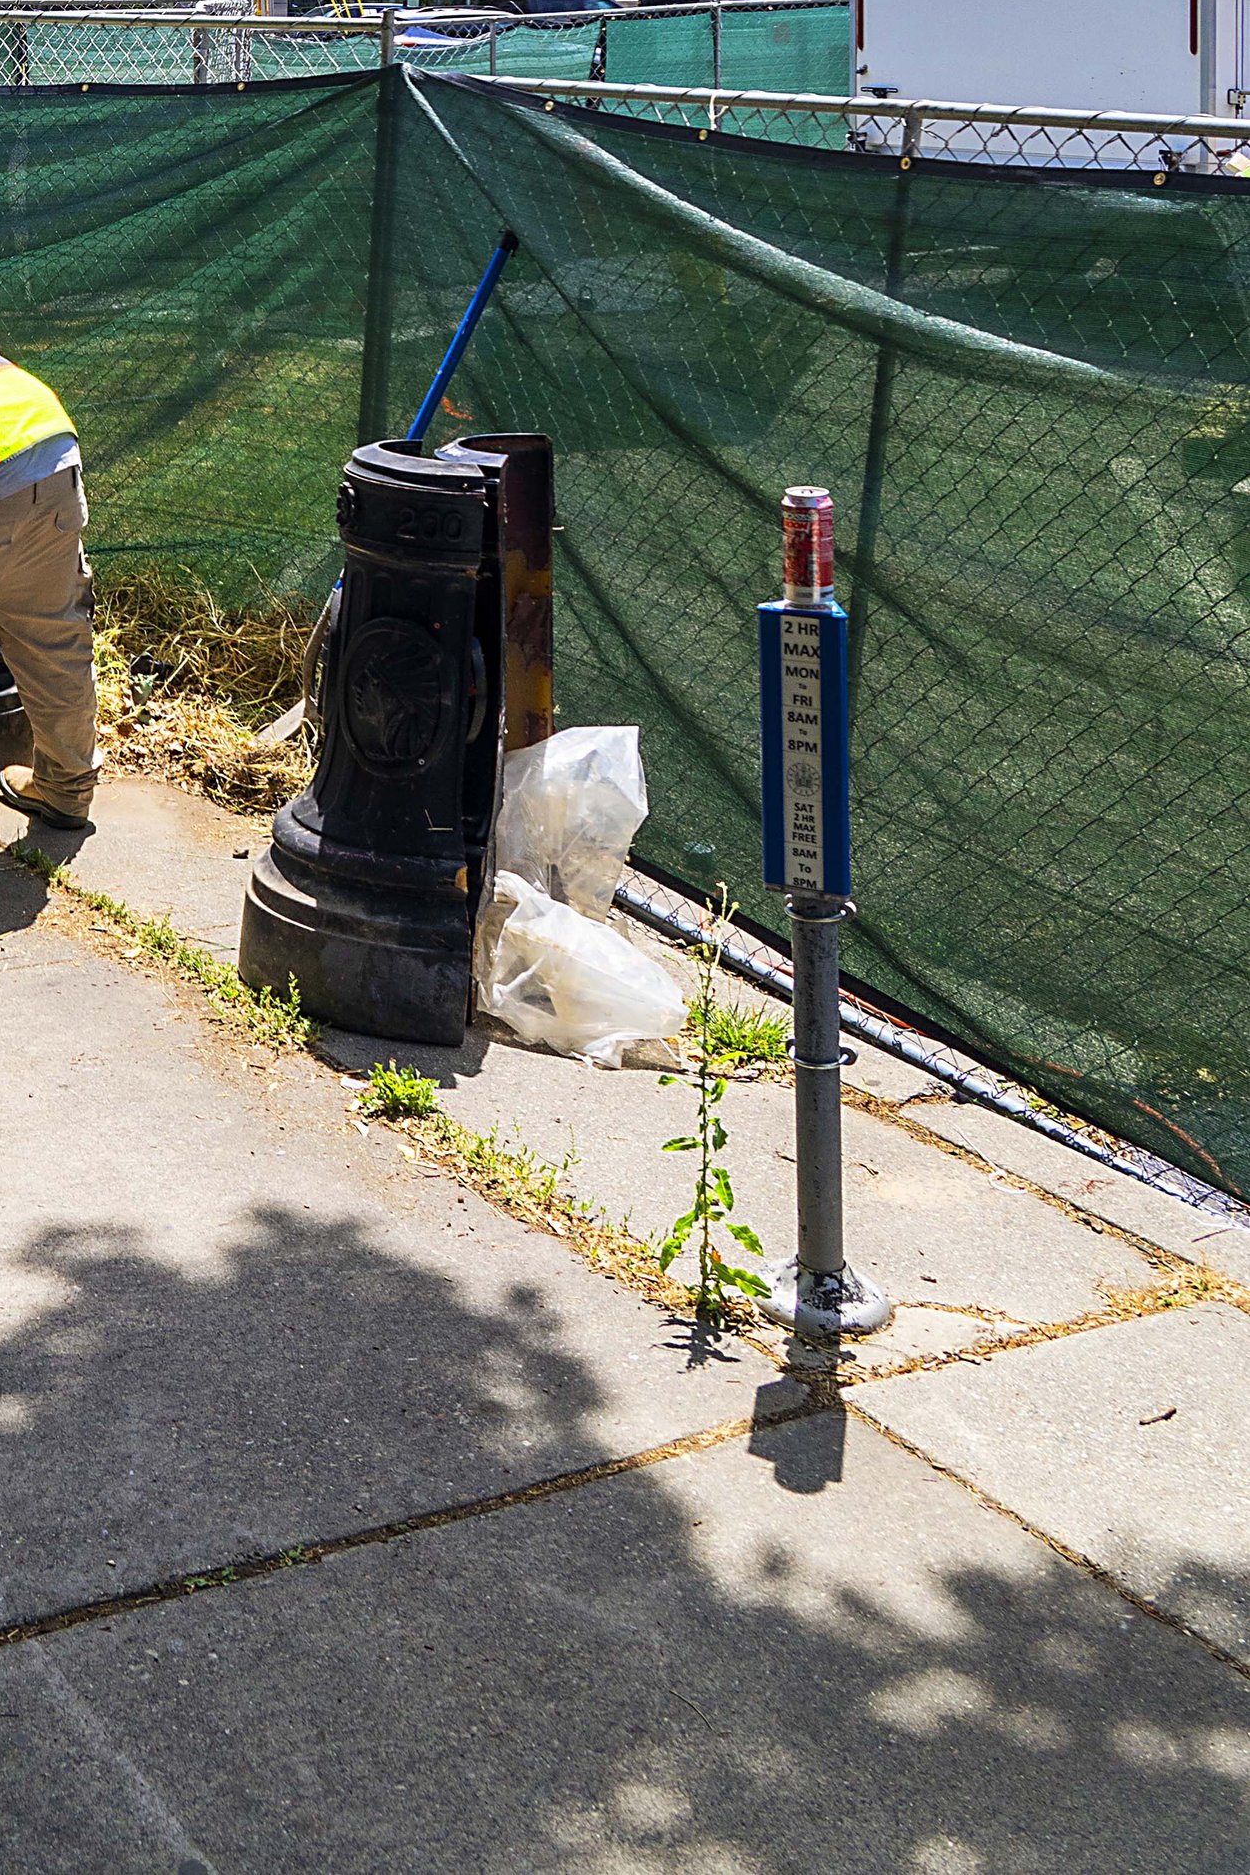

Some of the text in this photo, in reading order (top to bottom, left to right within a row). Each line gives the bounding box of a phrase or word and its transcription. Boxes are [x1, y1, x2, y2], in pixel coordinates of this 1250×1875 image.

[784, 621, 819, 637] 2 HR
[784, 642, 821, 659] MAX
[785, 666, 819, 680] MON
[792, 694, 812, 707] FRI
[787, 711, 818, 725] 8AM
[788, 739, 818, 754] 8PM
[794, 802, 814, 814] SAT
[793, 813, 815, 824] 2 HR
[793, 823, 816, 833] MAX
[792, 832, 817, 844] FREE
[792, 847, 818, 860] 8AM
[798, 863, 812, 874] To
[792, 877, 817, 890] 8PM
